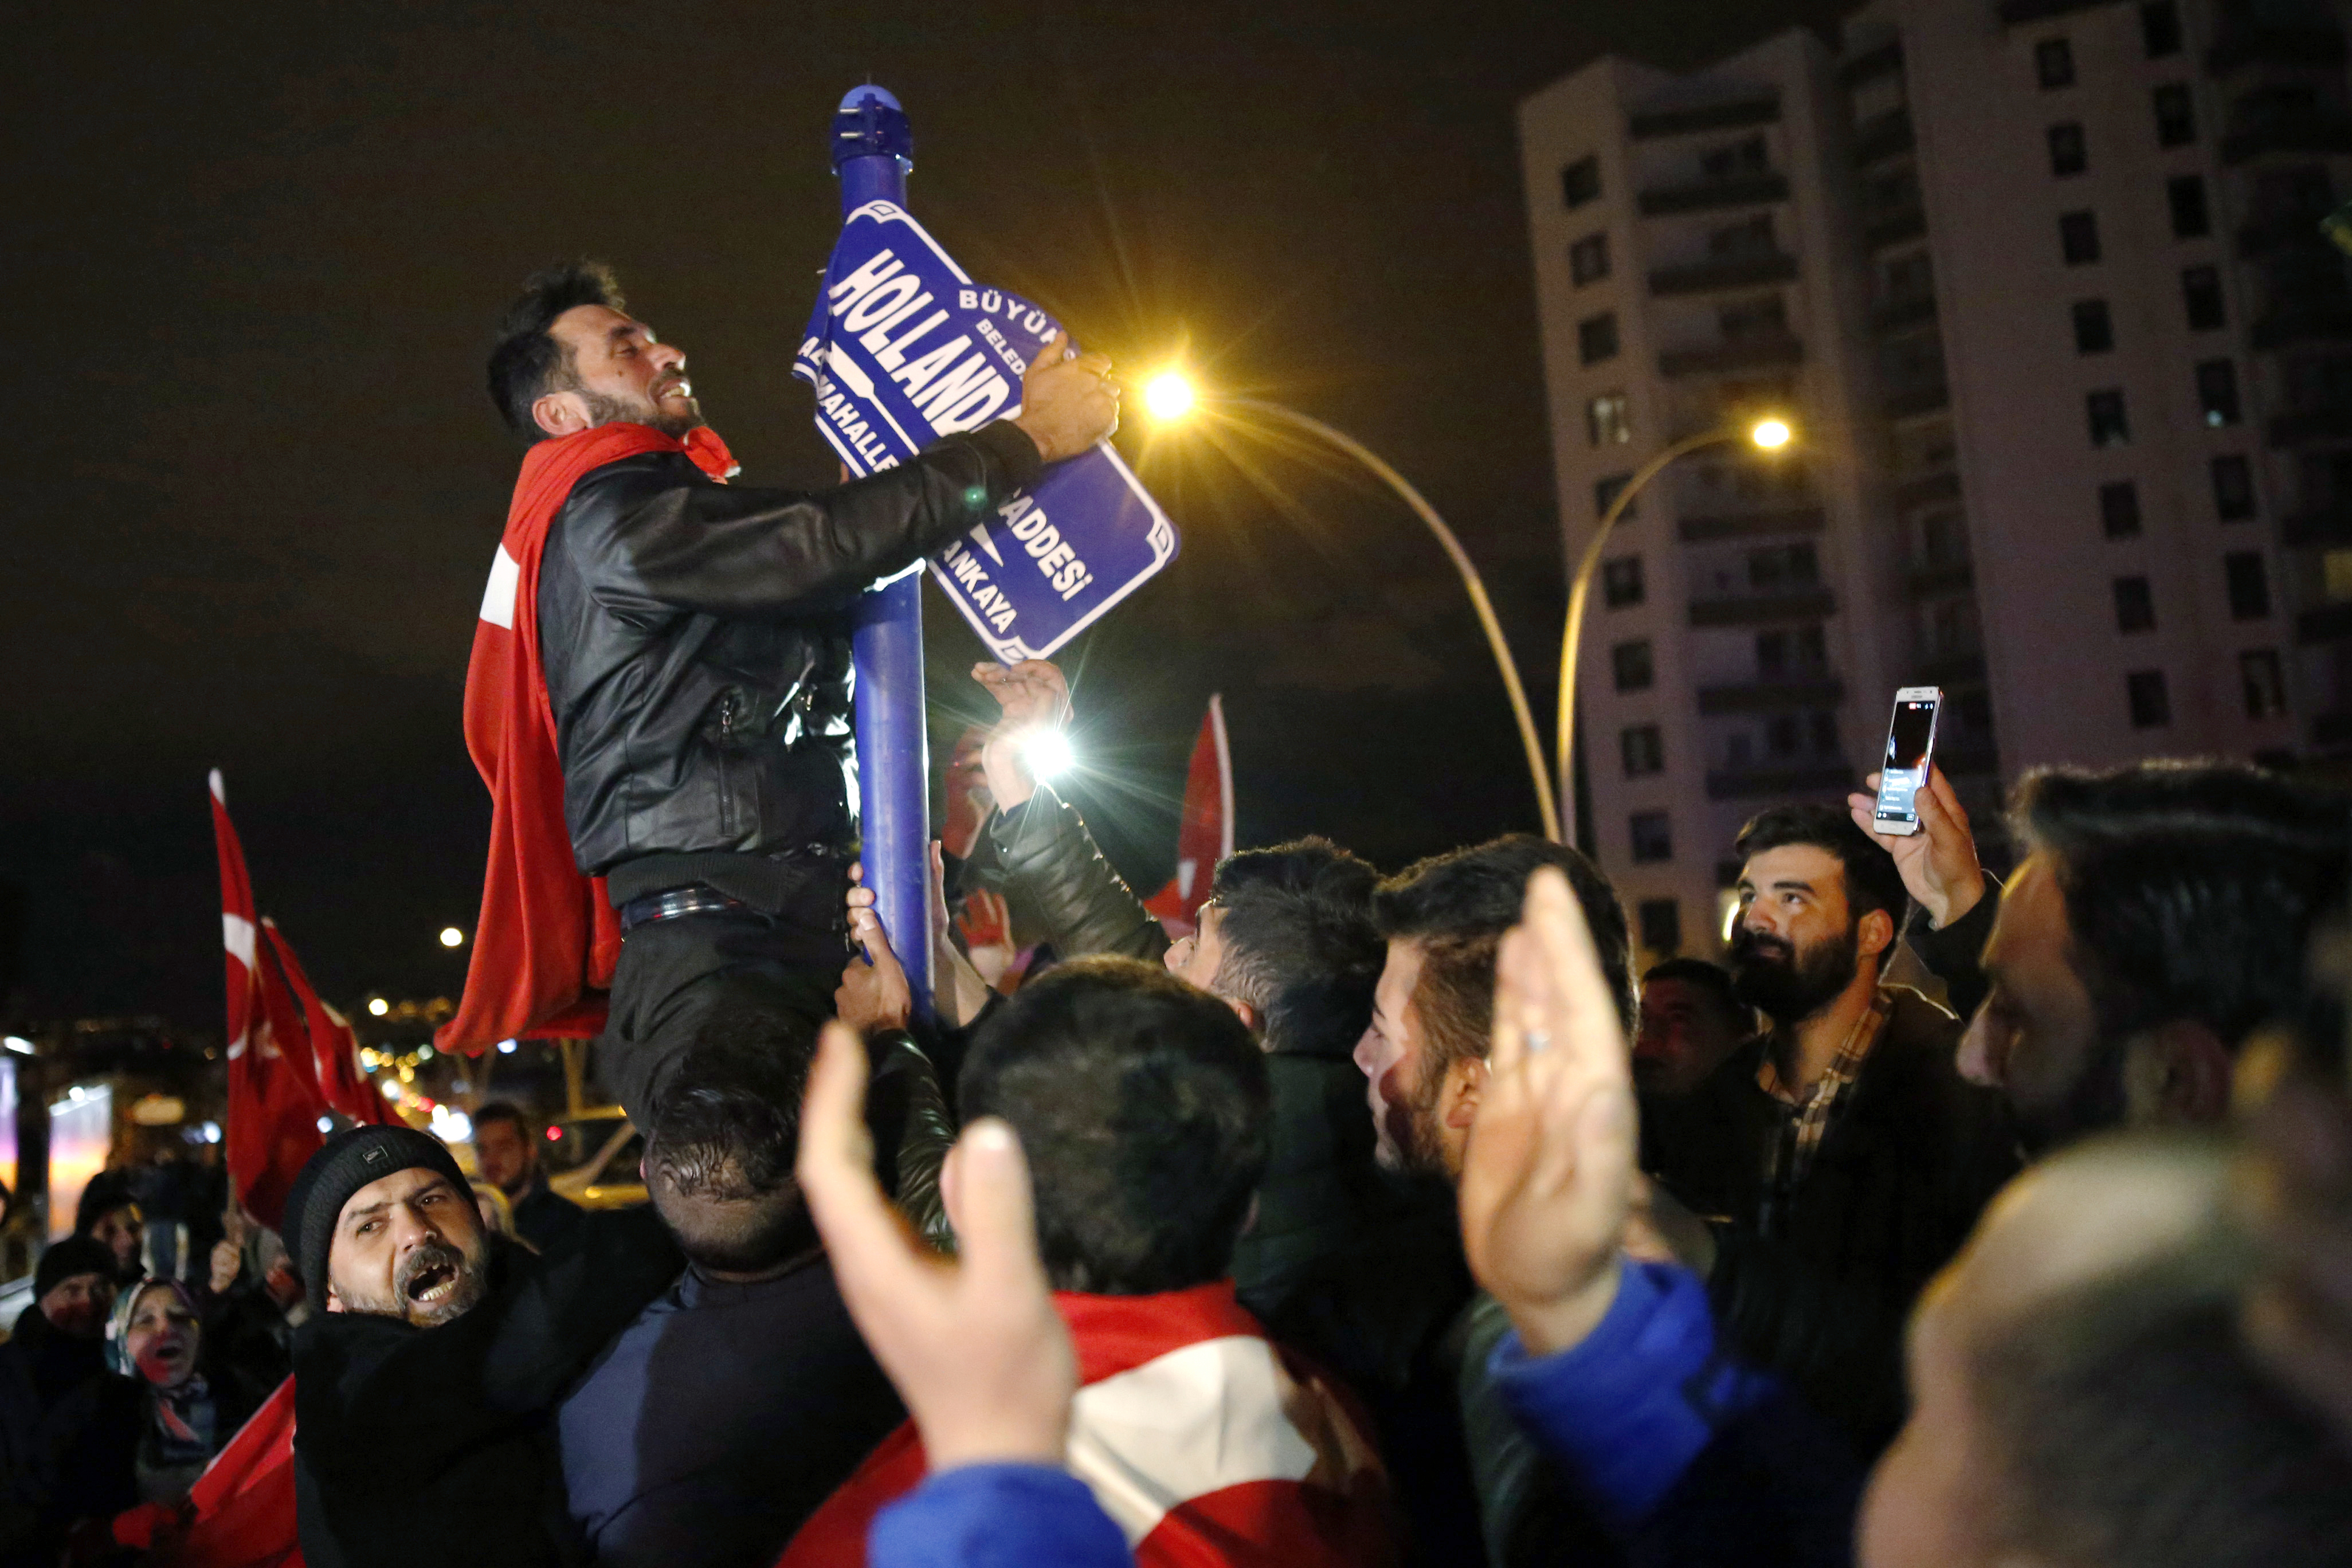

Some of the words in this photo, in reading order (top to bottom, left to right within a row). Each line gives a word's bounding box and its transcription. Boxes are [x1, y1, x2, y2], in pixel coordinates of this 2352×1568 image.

[975, 318, 1027, 381] BELED
[817, 374, 900, 473] MAHALLE
[943, 540, 1017, 634] ANKAYA
[998, 487, 1093, 602] ADDESİ
